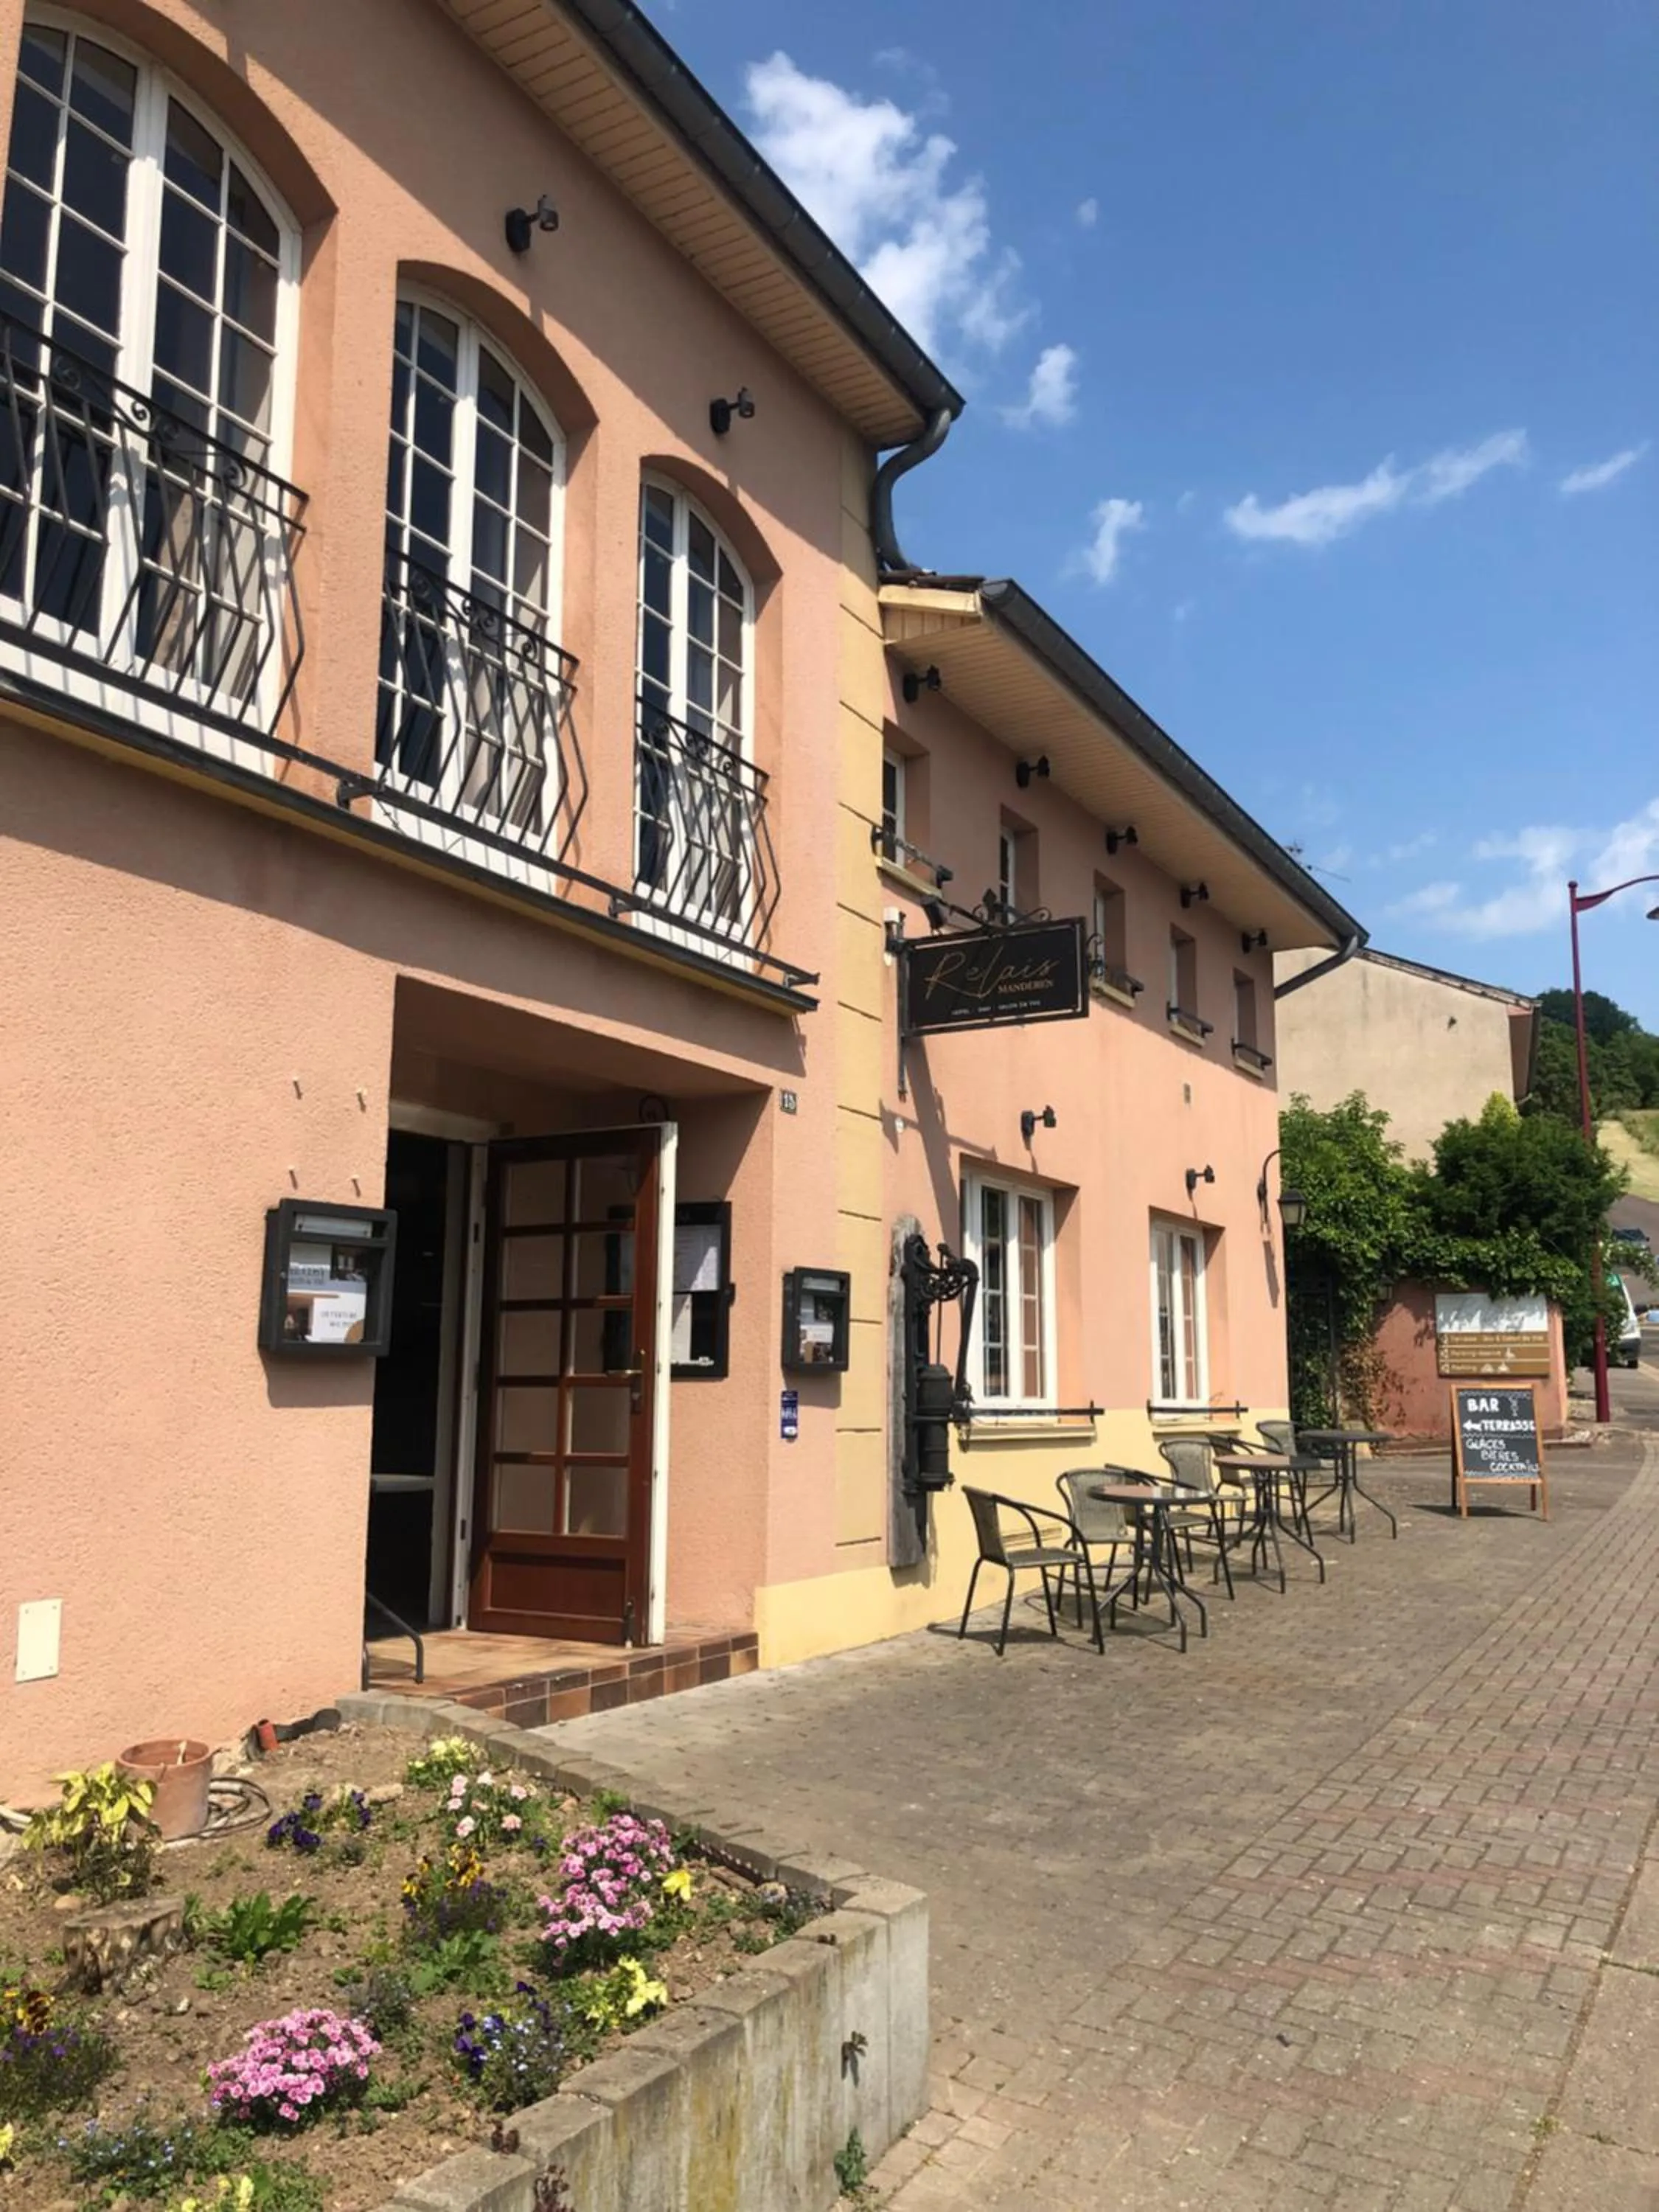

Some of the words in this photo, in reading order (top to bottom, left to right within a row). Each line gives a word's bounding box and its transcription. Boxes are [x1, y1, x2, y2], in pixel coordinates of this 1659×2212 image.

[924, 945, 1060, 1000] Relais
[1467, 1398, 1500, 1412] BAR
[1481, 1420, 1536, 1432] TERRASSE
[1466, 1439, 1506, 1450] GLACES
